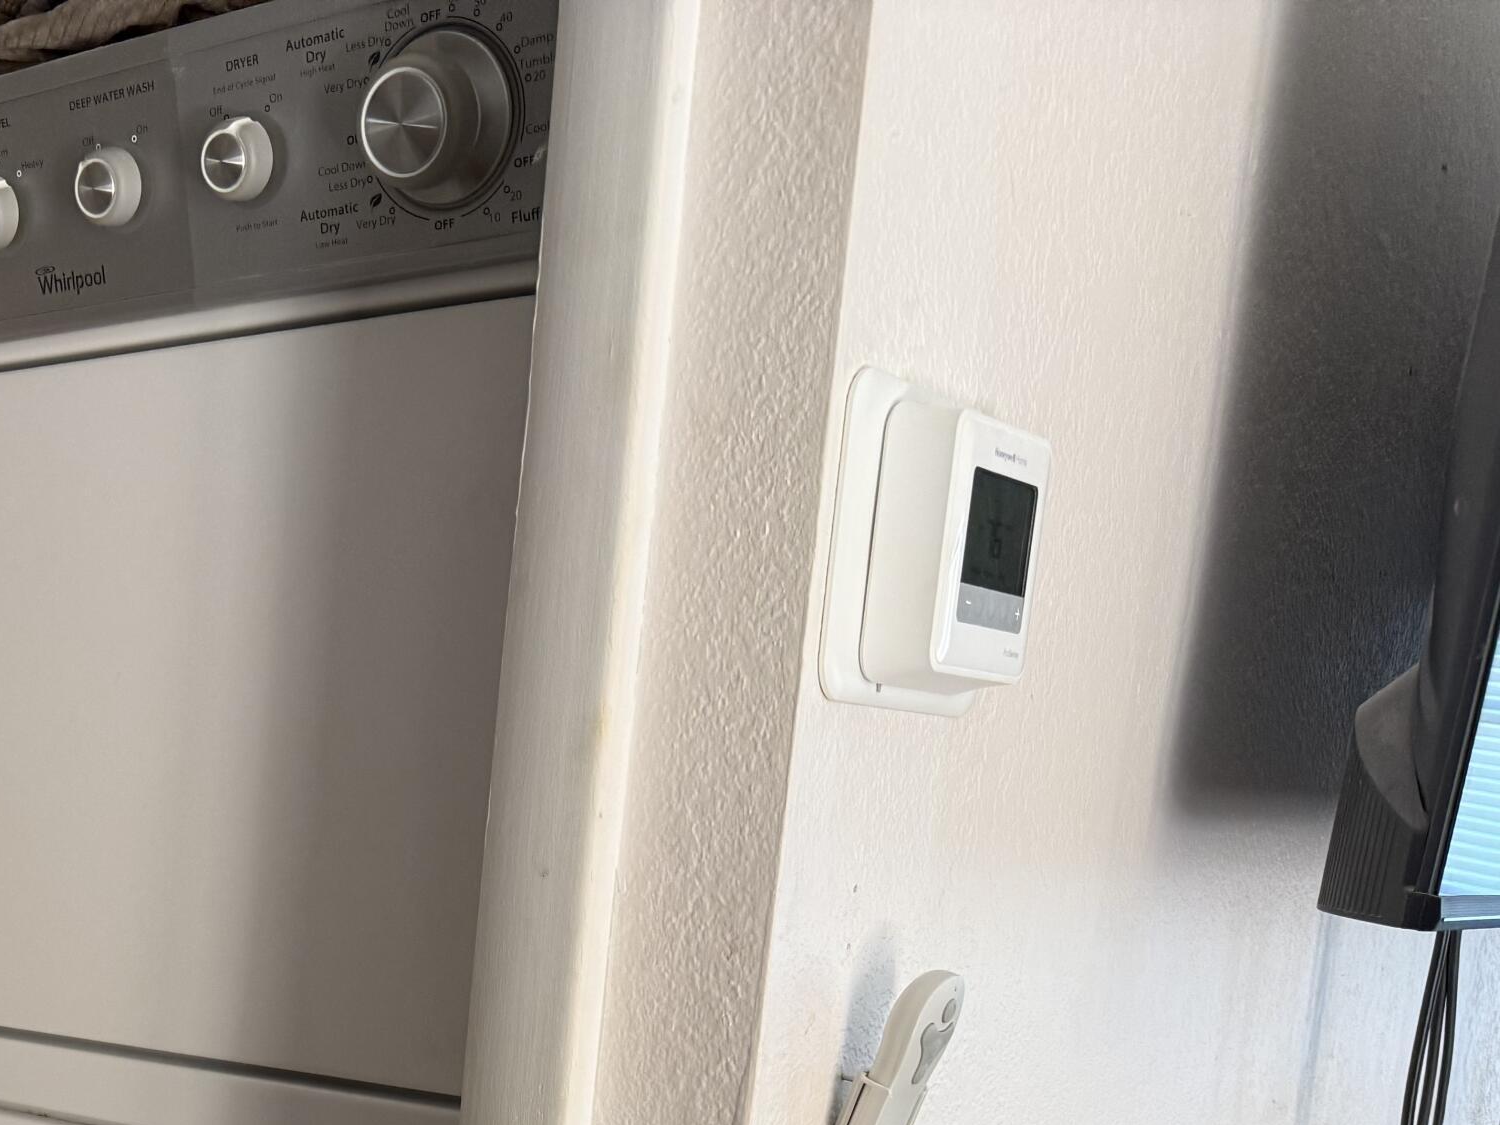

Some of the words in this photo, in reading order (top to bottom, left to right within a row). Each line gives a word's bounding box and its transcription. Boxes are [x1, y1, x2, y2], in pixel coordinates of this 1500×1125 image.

[388, 4, 410, 19] Cool
[421, 9, 441, 22] OFF
[385, 19, 414, 32] Down
[286, 27, 344, 52] Automatic
[346, 42, 365, 52] Less
[368, 36, 385, 47] Dry
[226, 54, 258, 72] DRYER
[306, 50, 326, 63] Dry
[520, 52, 553, 68] Tumbl
[534, 71, 545, 81] 20
[324, 82, 344, 94] Very
[347, 78, 364, 90] Dry
[69, 96, 91, 111] DEEP
[93, 88, 125, 104] WATER
[126, 80, 155, 98] WASH
[270, 93, 282, 103] On
[514, 156, 534, 168] OFF
[318, 165, 339, 177] Cool
[329, 181, 348, 192] Less
[351, 178, 366, 190] Dry
[511, 191, 522, 201] 20
[300, 202, 359, 222] Automatic
[512, 207, 540, 223] Fluff
[320, 222, 340, 235] Dry
[356, 219, 376, 230] Very
[380, 215, 396, 227] Dry
[435, 219, 454, 230] OFF
[38, 265, 106, 295] Whirlpool
